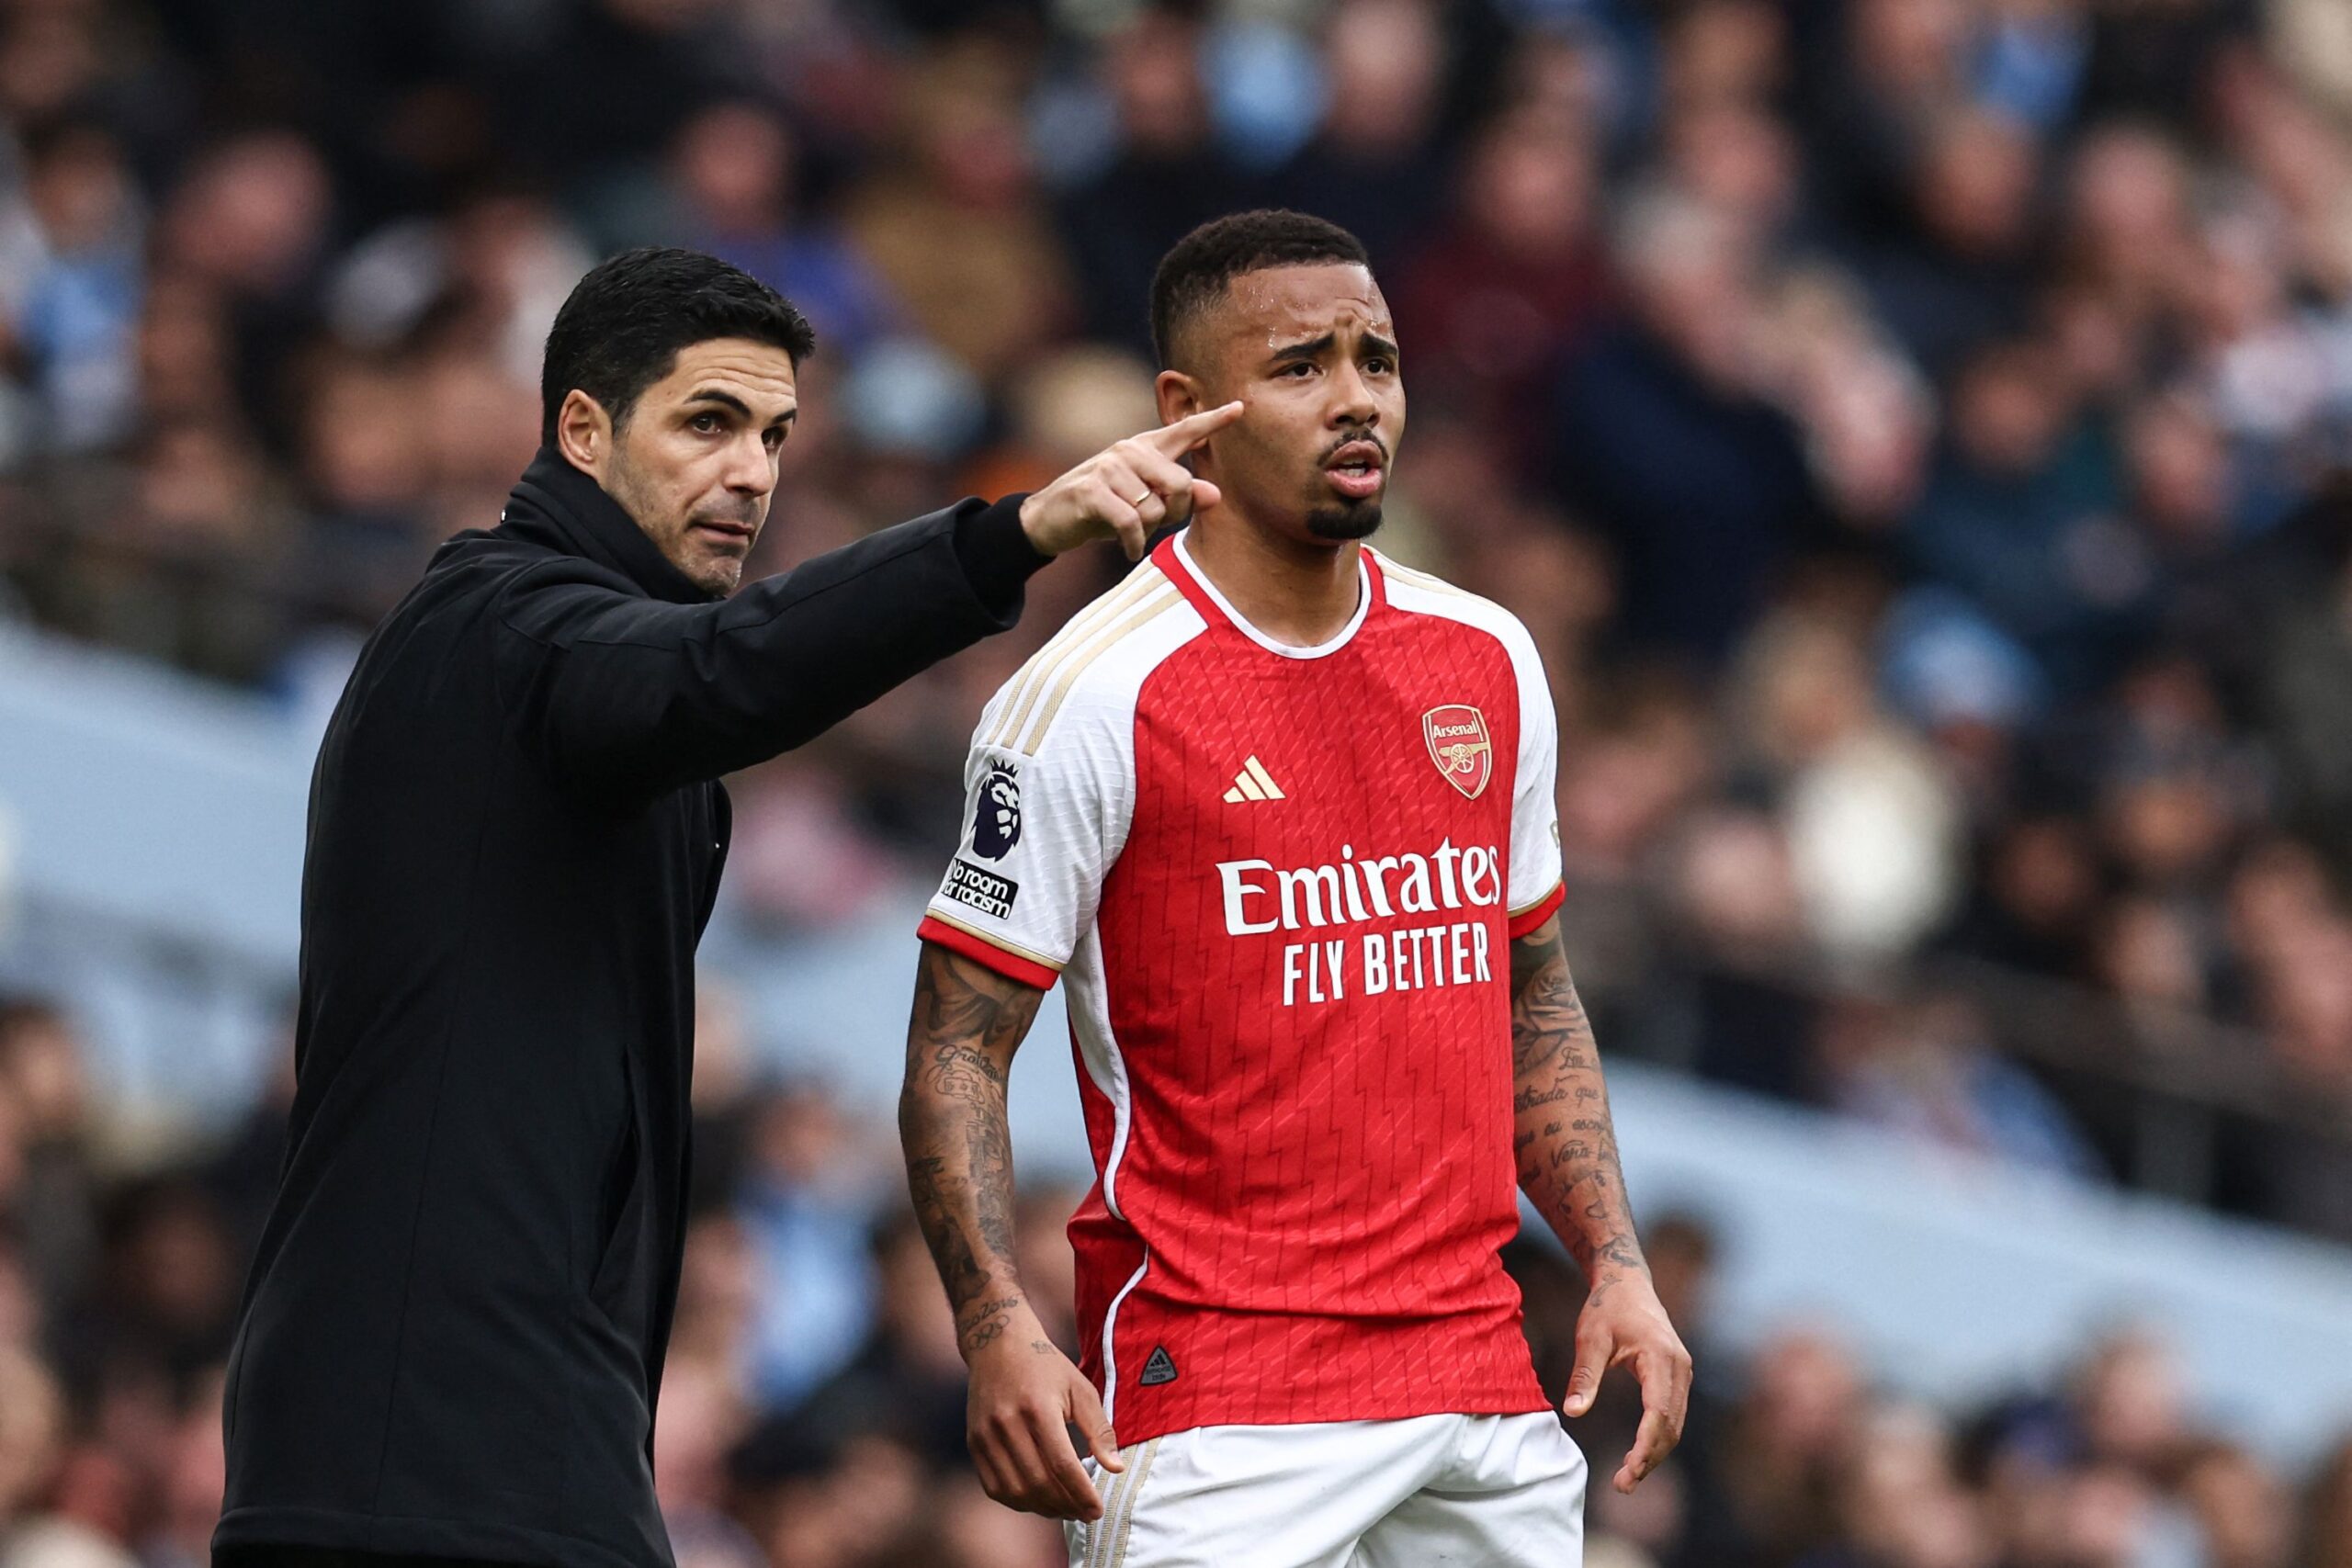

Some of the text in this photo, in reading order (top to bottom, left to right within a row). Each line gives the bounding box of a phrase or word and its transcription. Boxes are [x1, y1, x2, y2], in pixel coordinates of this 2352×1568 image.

[1433, 720, 1478, 739] Arsenal
[941, 877, 1011, 919] or racism
[962, 868, 1009, 900] room
[1215, 836, 1501, 936] Emirates
[1283, 921, 1492, 1007] FLY BETTER
